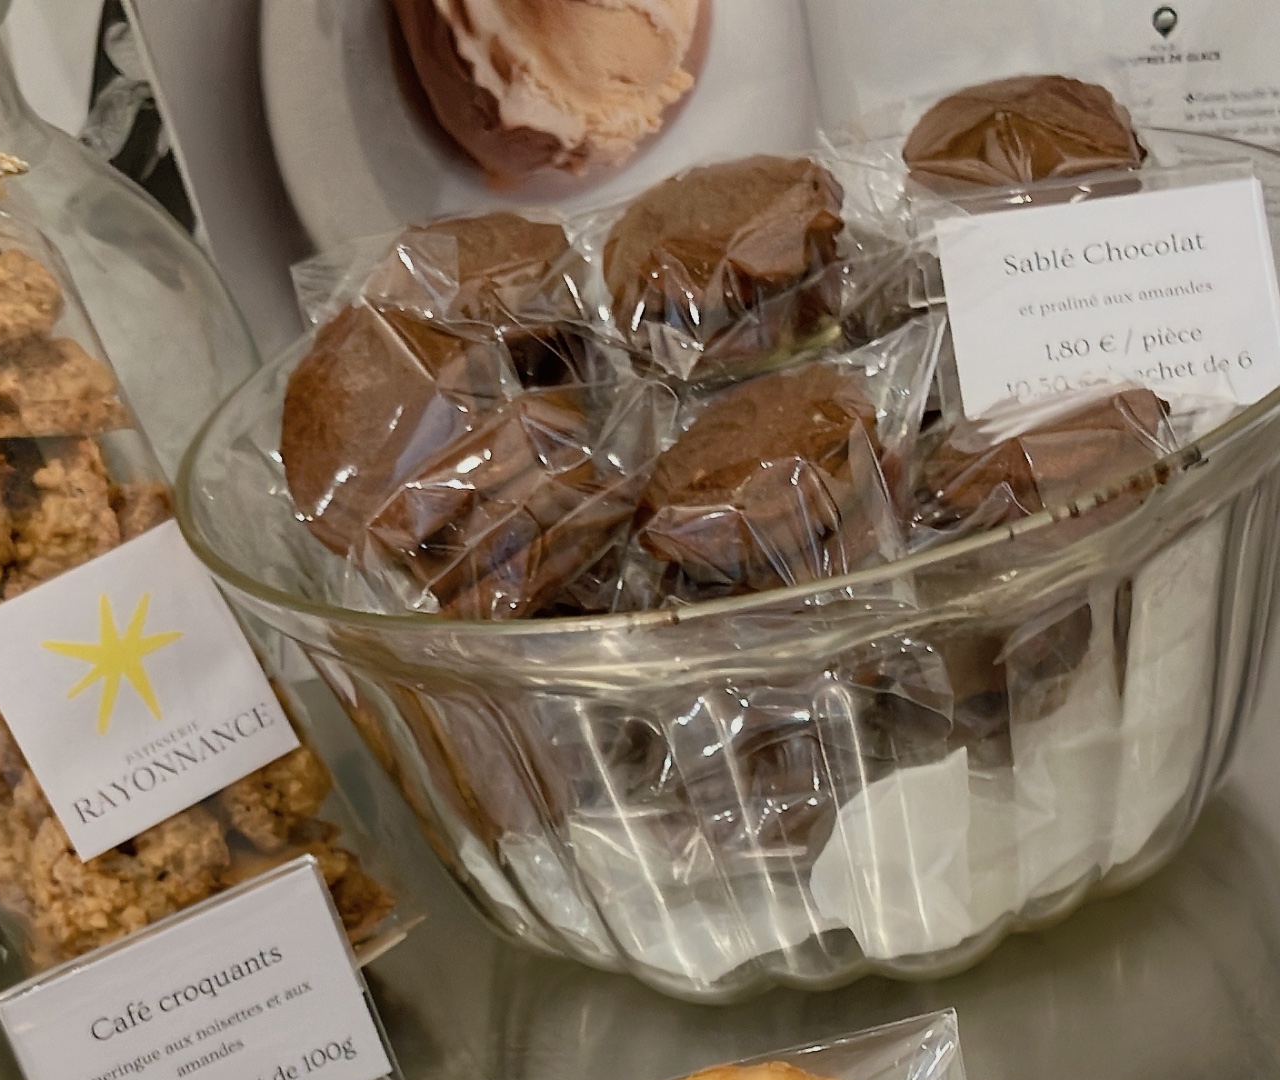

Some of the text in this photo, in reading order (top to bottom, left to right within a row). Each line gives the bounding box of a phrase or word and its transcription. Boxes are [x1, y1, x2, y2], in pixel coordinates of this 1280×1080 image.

[1003, 232, 1208, 277] Sablé Chocolat
[1020, 280, 1213, 318] et praliné aux amandes
[1044, 340, 1090, 362] 1,80
[1099, 334, 1116, 352] €
[1142, 327, 1203, 353] pièce
[1203, 355, 1229, 373] de
[1237, 350, 1253, 370] 6
[72, 702, 276, 824] RAYONNANCE
[90, 946, 283, 1041] Café croquants
[164, 1034, 194, 1056] aux
[195, 1004, 264, 1042] noisettes
[266, 994, 283, 1009] et
[284, 981, 313, 1003] aux
[176, 1038, 245, 1078] amandes
[300, 1036, 358, 1074] 100g
